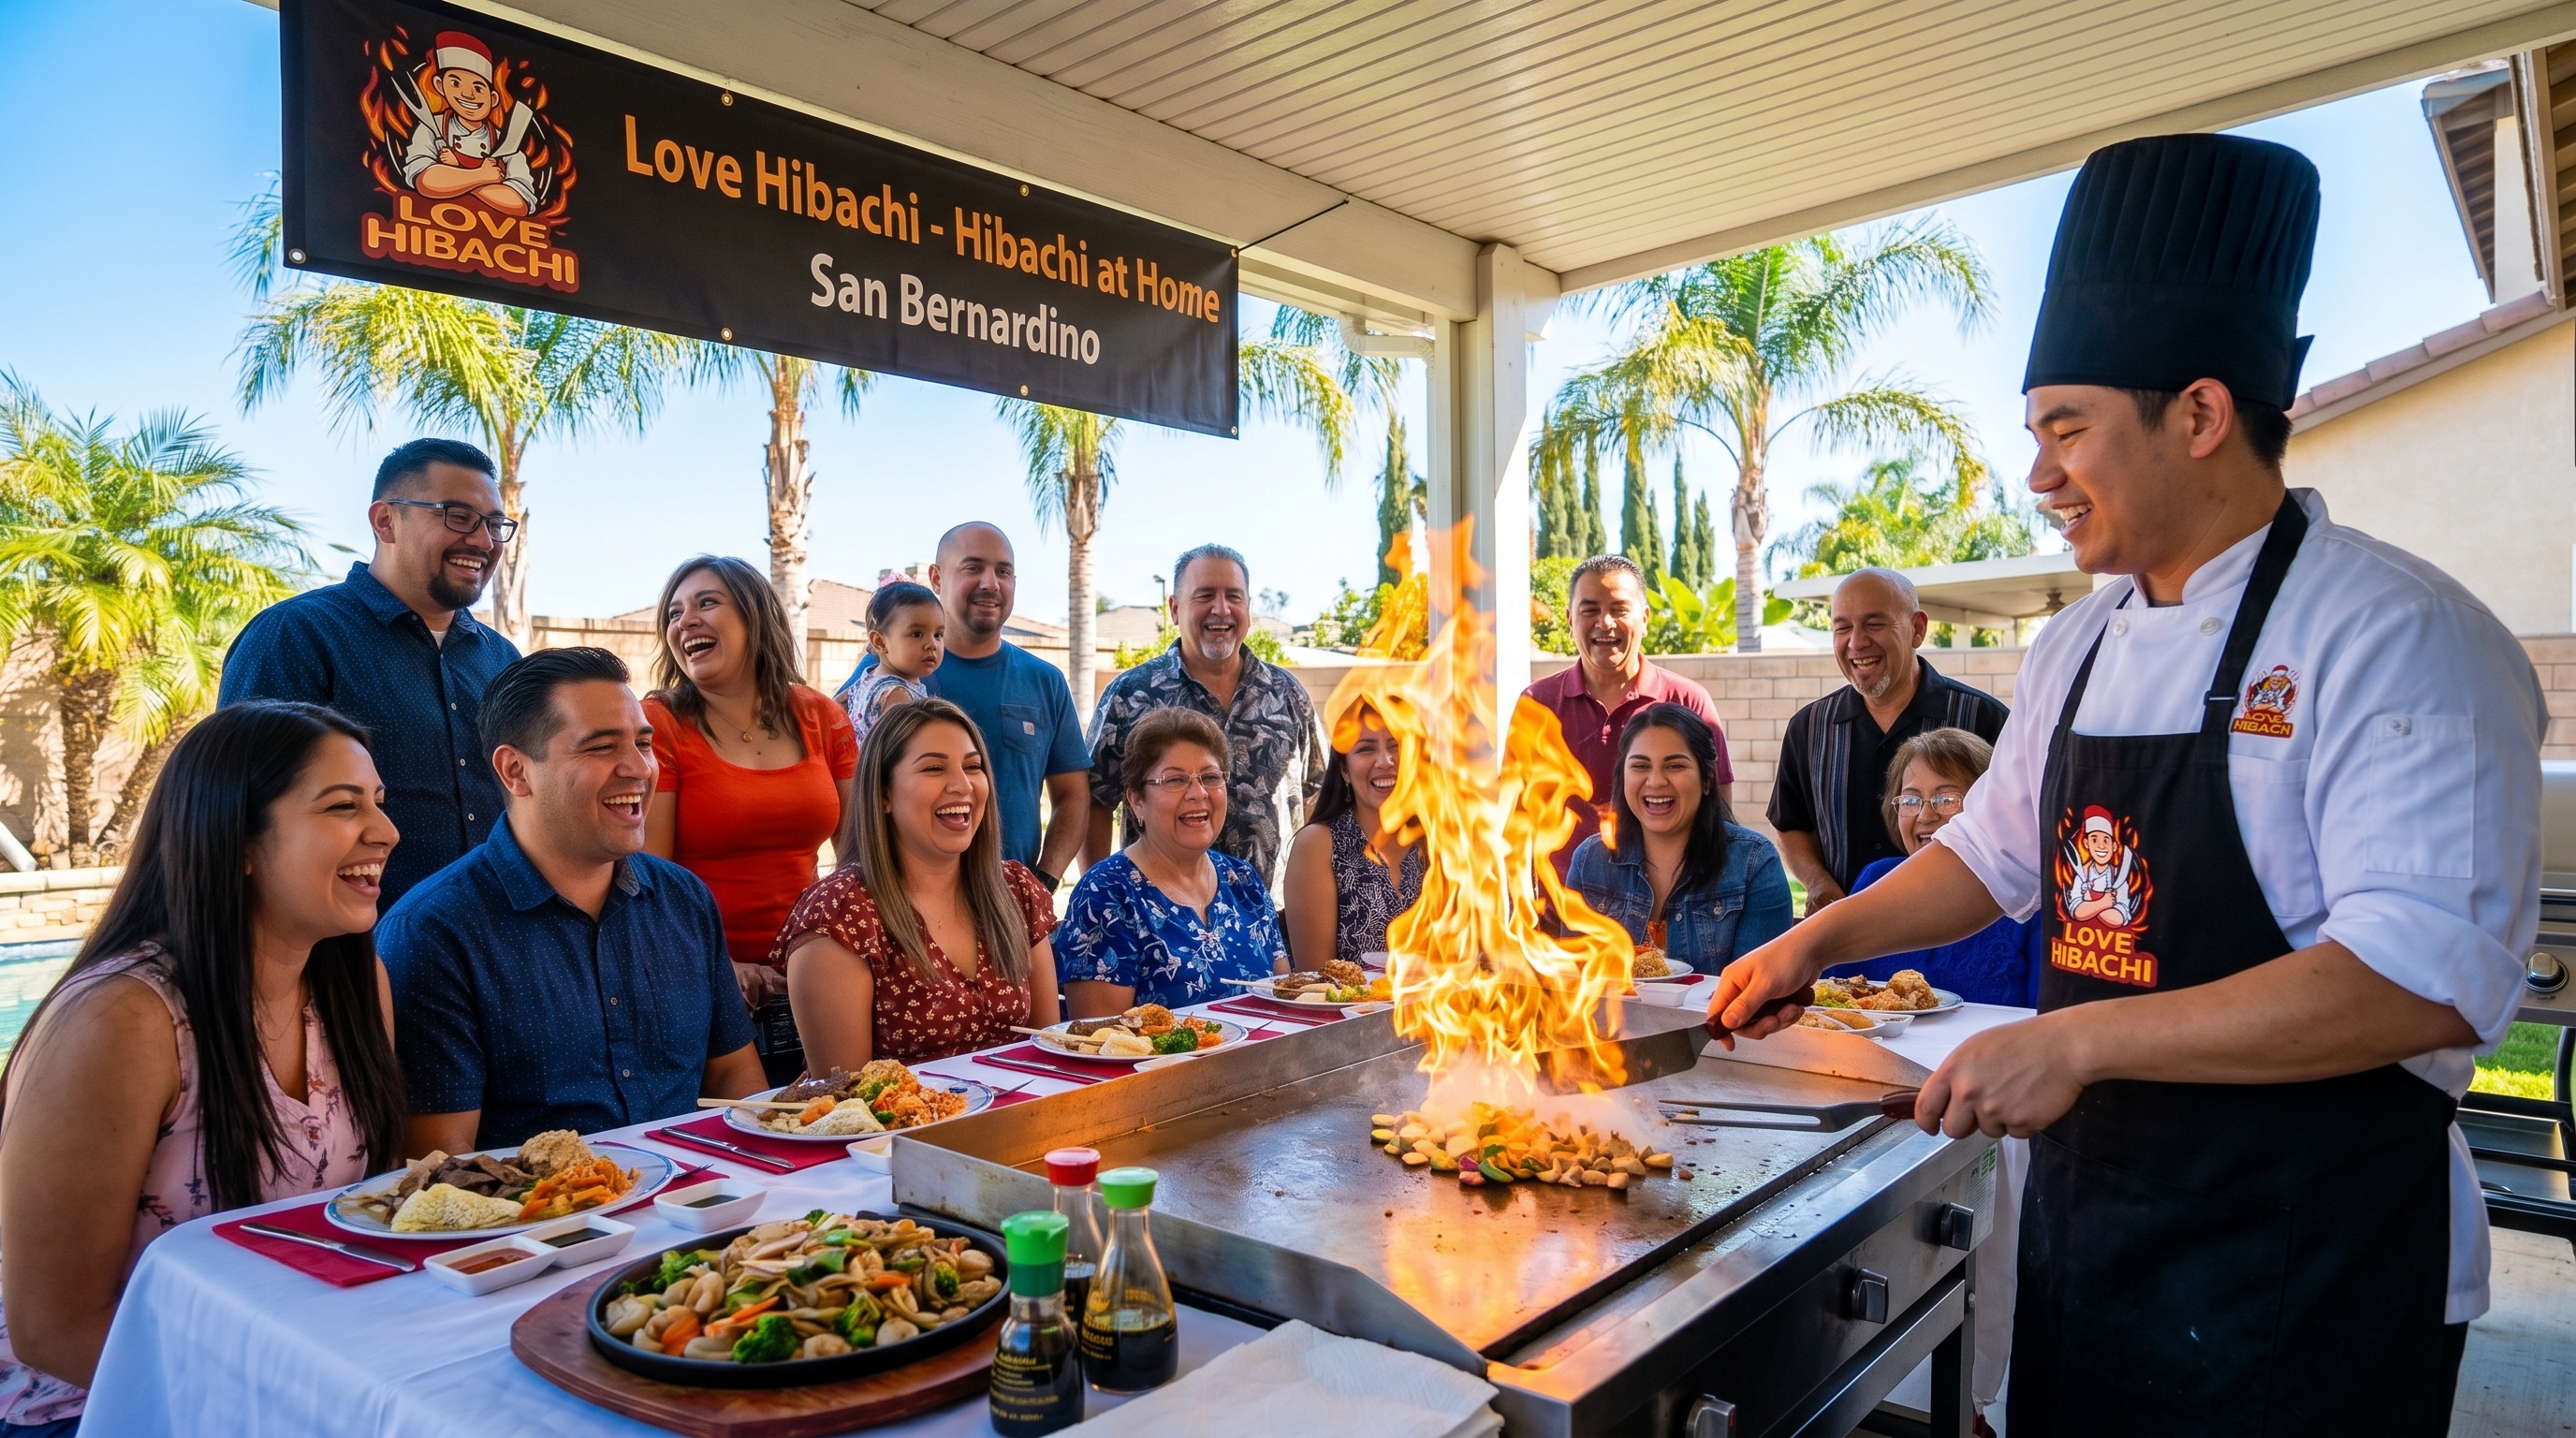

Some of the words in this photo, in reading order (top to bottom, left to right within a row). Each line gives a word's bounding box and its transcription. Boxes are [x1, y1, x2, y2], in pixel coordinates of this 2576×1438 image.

[399, 195, 549, 250] LOVE
[624, 114, 742, 198] Love
[755, 150, 920, 244] Hibachi
[930, 224, 944, 236] -
[955, 206, 1089, 287] Hibachi
[1097, 257, 1129, 299] at
[1136, 257, 1220, 323] Home
[367, 217, 576, 285] HIBACHI
[811, 253, 887, 319] San
[900, 273, 1101, 365] Bernardino
[2051, 941, 2152, 983] HIBACHI
[2064, 922, 2132, 955] LOVE
